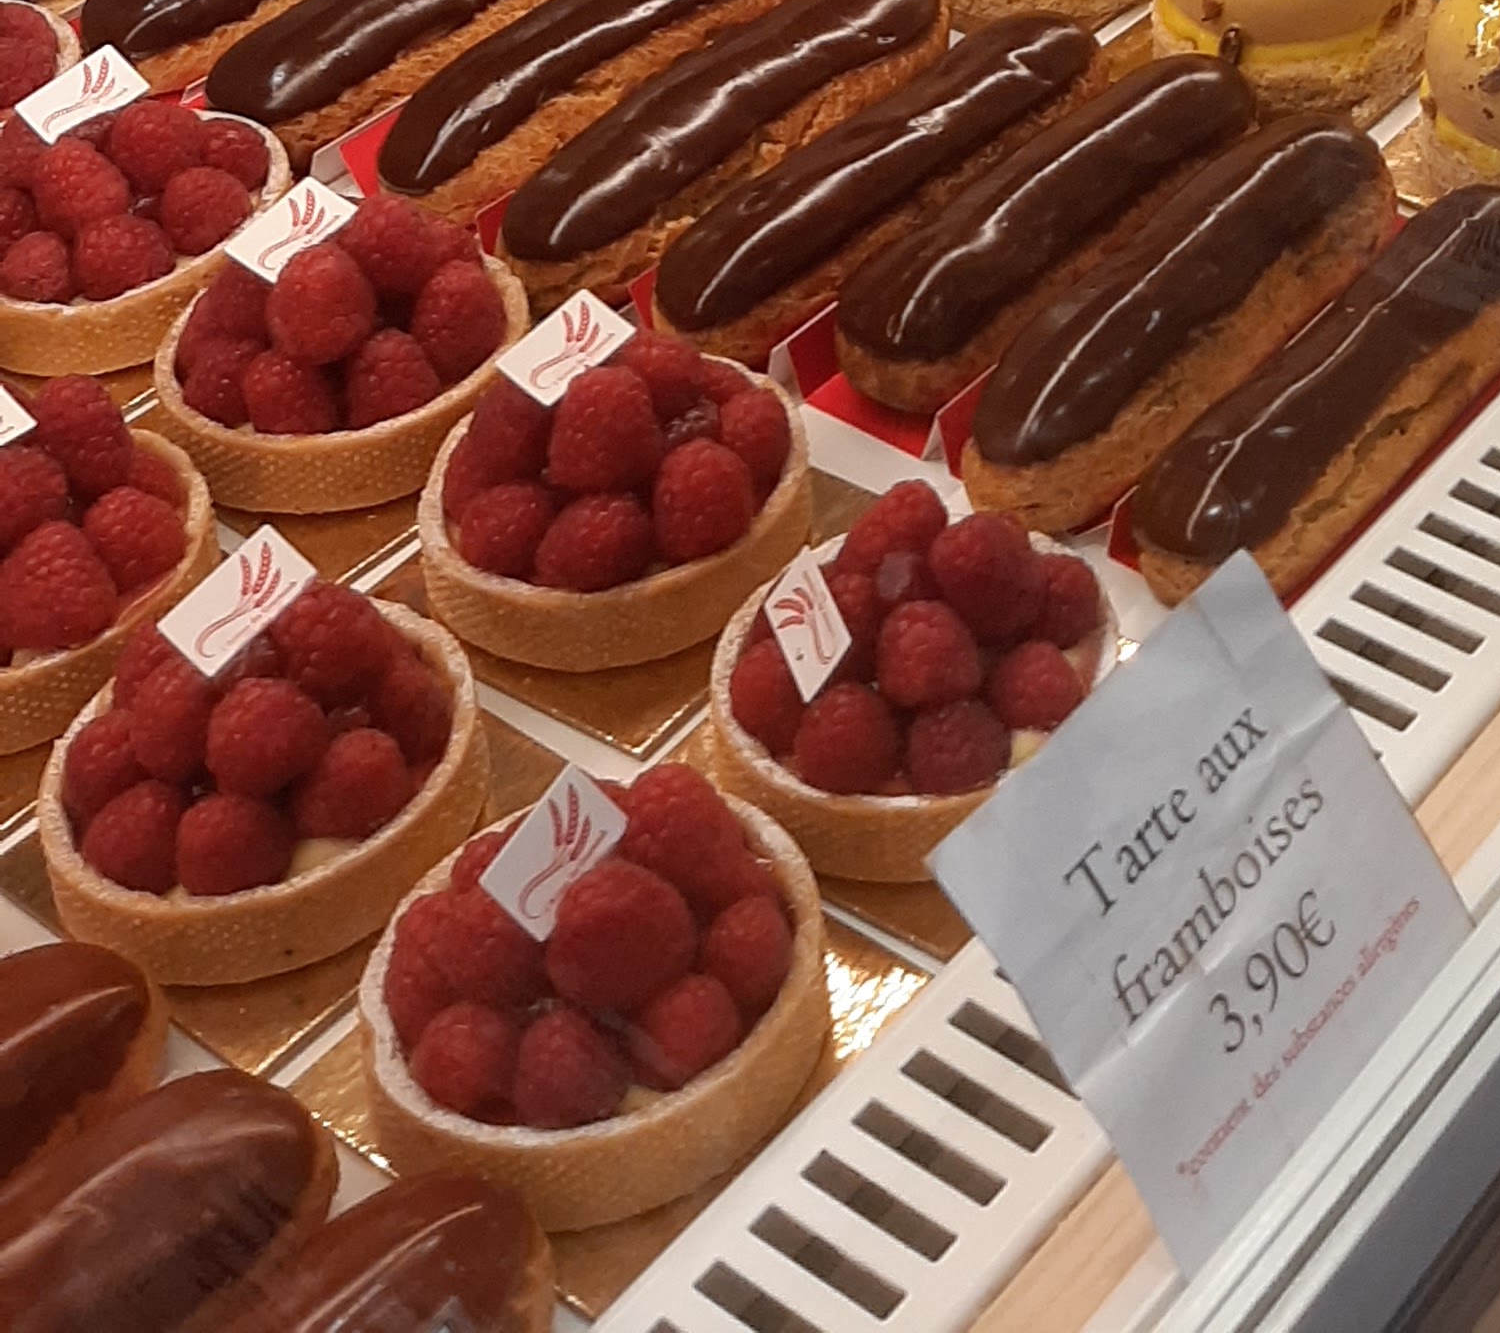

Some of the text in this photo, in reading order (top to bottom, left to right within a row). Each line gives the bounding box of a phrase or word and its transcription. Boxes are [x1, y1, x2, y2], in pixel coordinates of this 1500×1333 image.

[1062, 706, 1270, 919] Tarte aux
[1111, 773, 1326, 1028] framboises
[1208, 888, 1336, 1054] 3,90€
